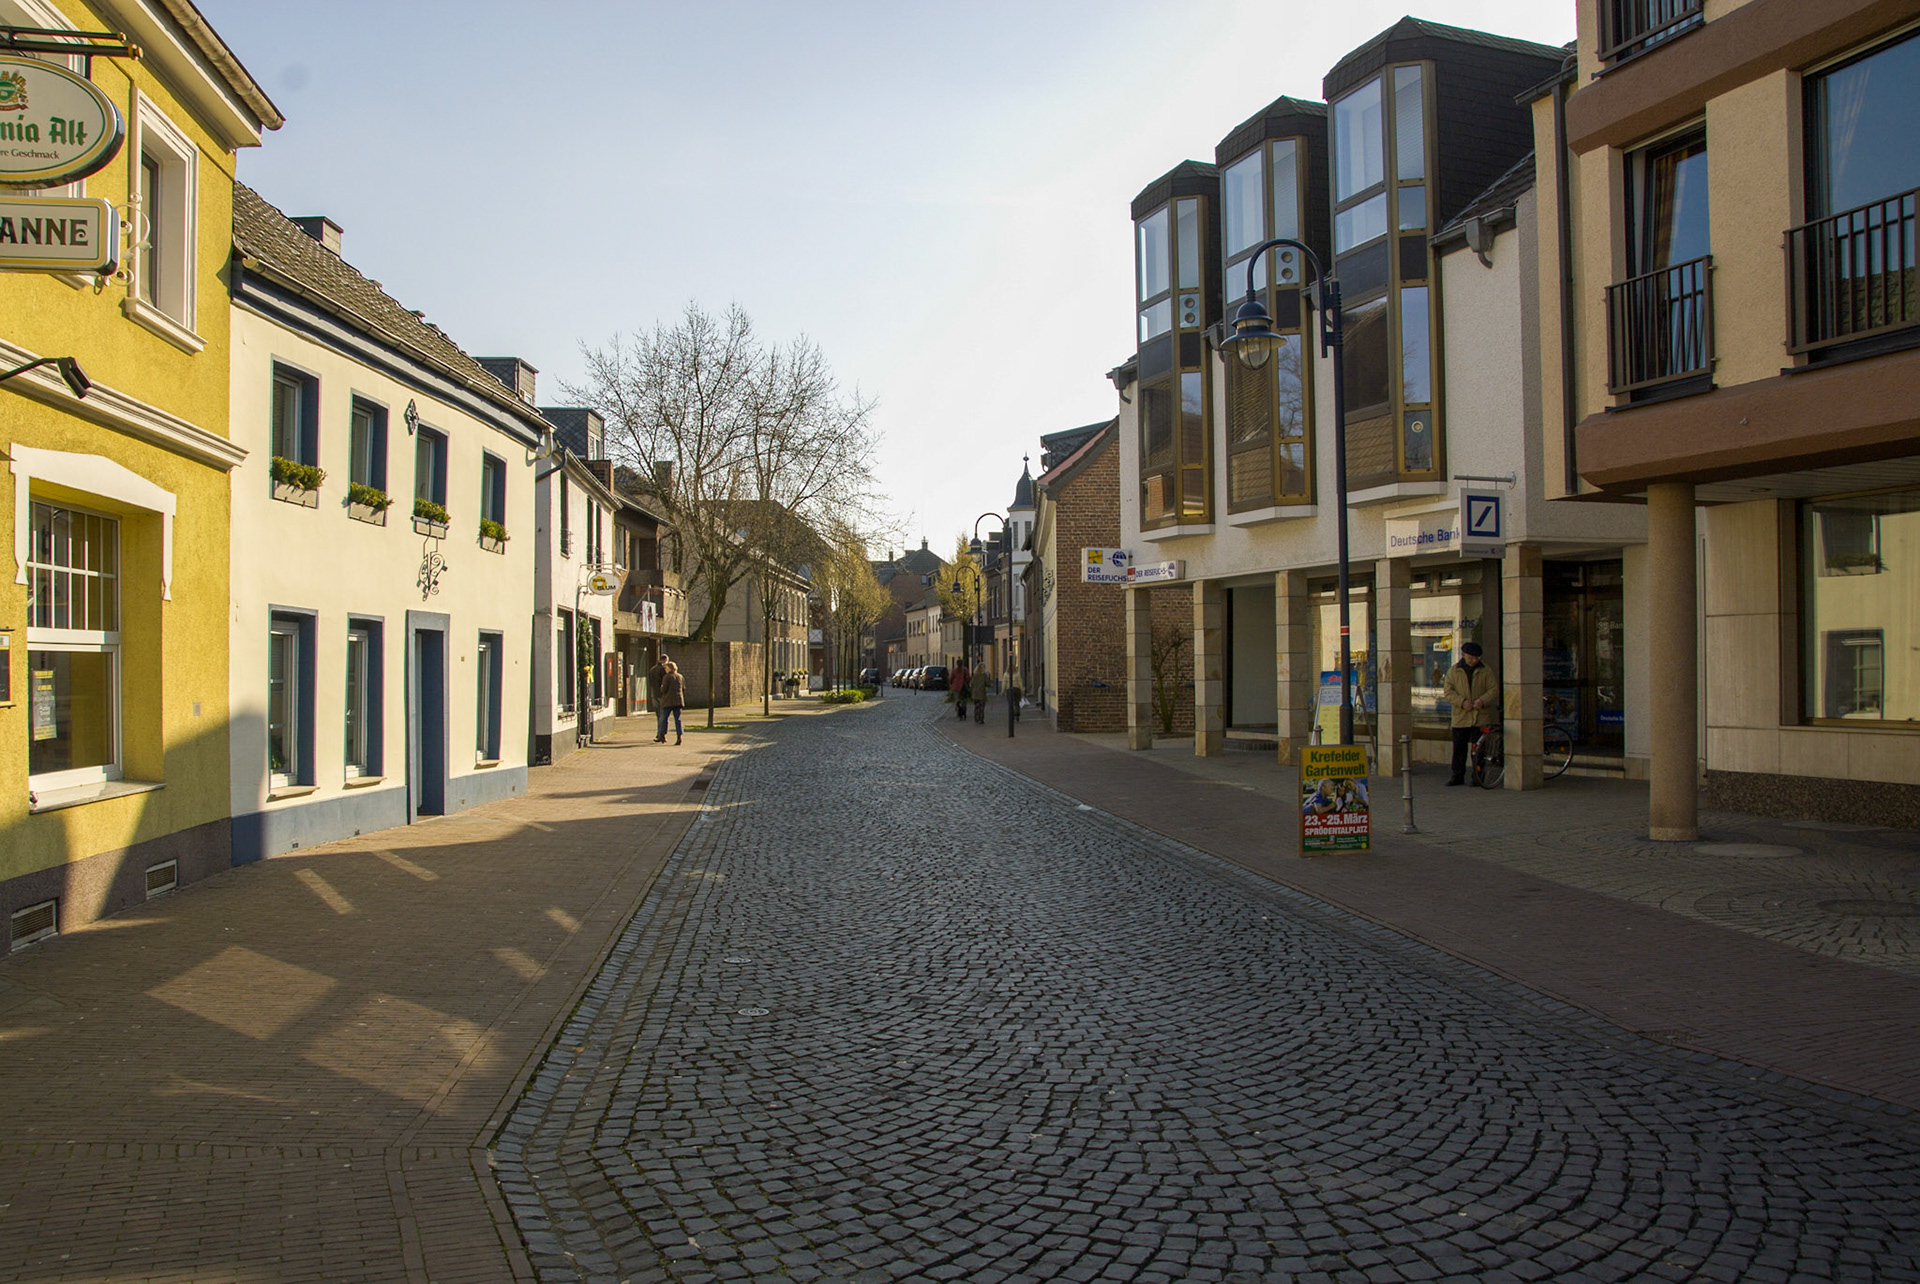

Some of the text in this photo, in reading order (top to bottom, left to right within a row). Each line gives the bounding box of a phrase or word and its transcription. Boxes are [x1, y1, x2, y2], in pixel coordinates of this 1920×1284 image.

[49, 116, 88, 146] Alt
[11, 148, 60, 159] Geschmack
[0, 216, 89, 246] ANNE
[1390, 531, 1434, 548] Deutsche
[1087, 566, 1101, 574] DER
[1087, 574, 1127, 582] REISEFUCHS
[1311, 750, 1360, 762] Krefelder
[1305, 763, 1366, 777] Gartenwelt
[1343, 813, 1368, 825] März
[1304, 825, 1368, 836] SPRÖDENTALPLATZ
